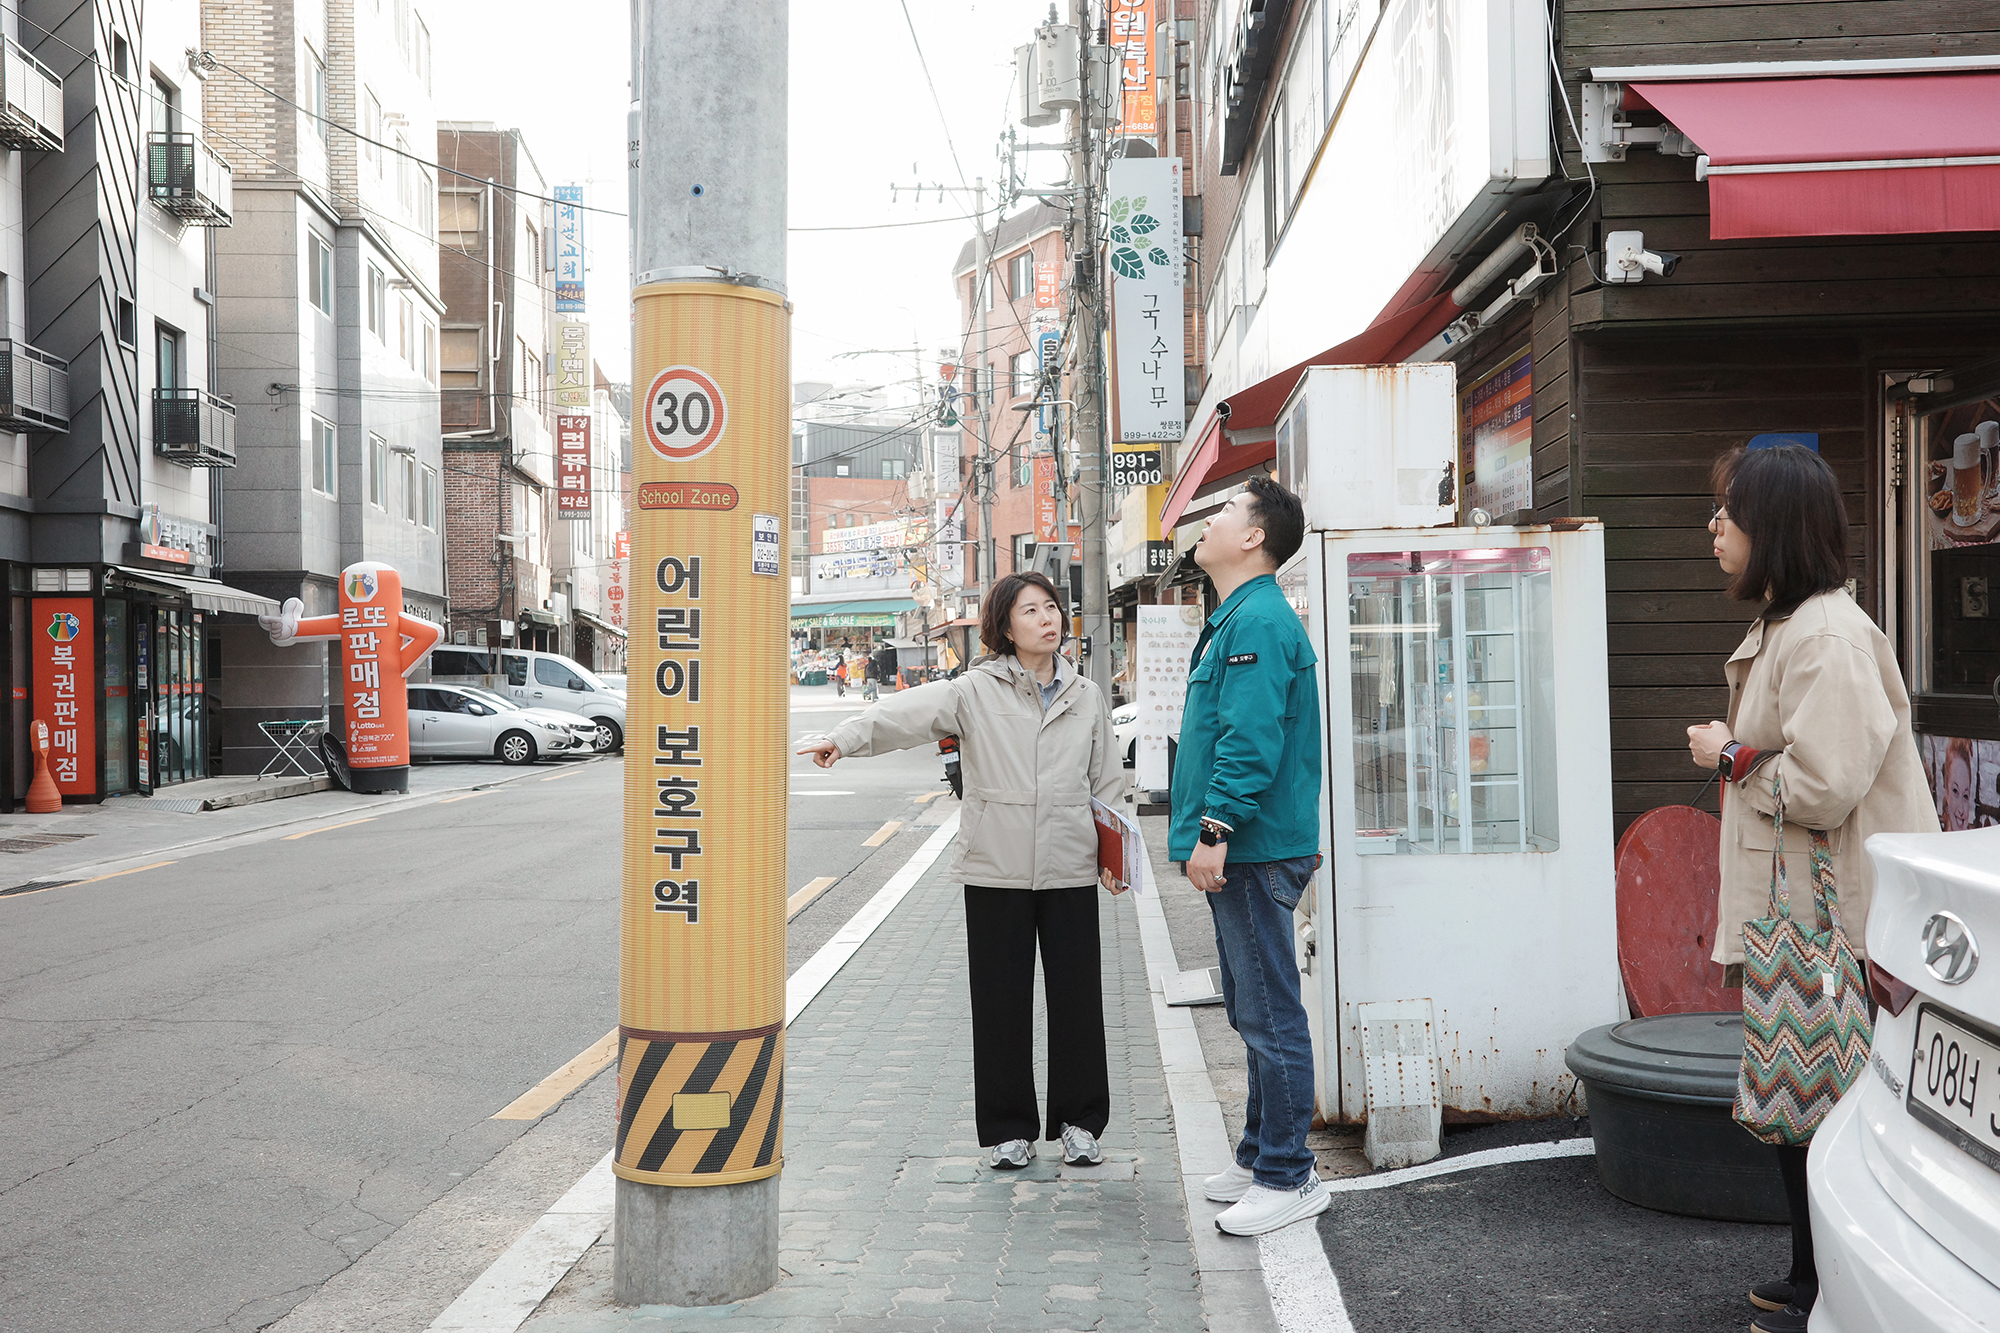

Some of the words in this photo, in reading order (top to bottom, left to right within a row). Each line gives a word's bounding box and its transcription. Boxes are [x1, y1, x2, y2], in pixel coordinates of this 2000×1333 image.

[1038, 263, 1056, 307] 인테리어
[1141, 294, 1169, 409] 국수나무
[560, 417, 588, 429] 대성
[655, 390, 711, 437] 30
[1160, 420, 1182, 430] 쌍문점
[1124, 431, 1182, 439] 999-1422~3
[561, 431, 587, 493] 컴퓨터
[1114, 453, 1154, 469] 991-
[1114, 470, 1161, 486] 8000
[560, 496, 589, 508] 학원
[641, 487, 686, 507] School
[690, 488, 732, 507] Zone
[342, 606, 388, 628] 로또
[808, 617, 822, 627] SALE
[840, 615, 854, 625] SALE
[1141, 617, 1168, 625] 국수나무
[655, 555, 702, 703] 어린이
[348, 631, 381, 718] 판매점
[51, 645, 79, 783] 복권판매점
[653, 724, 703, 924] 보호구역
[1927, 1031, 1981, 1118] 08너
[1298, 1175, 1321, 1199] HOKA
